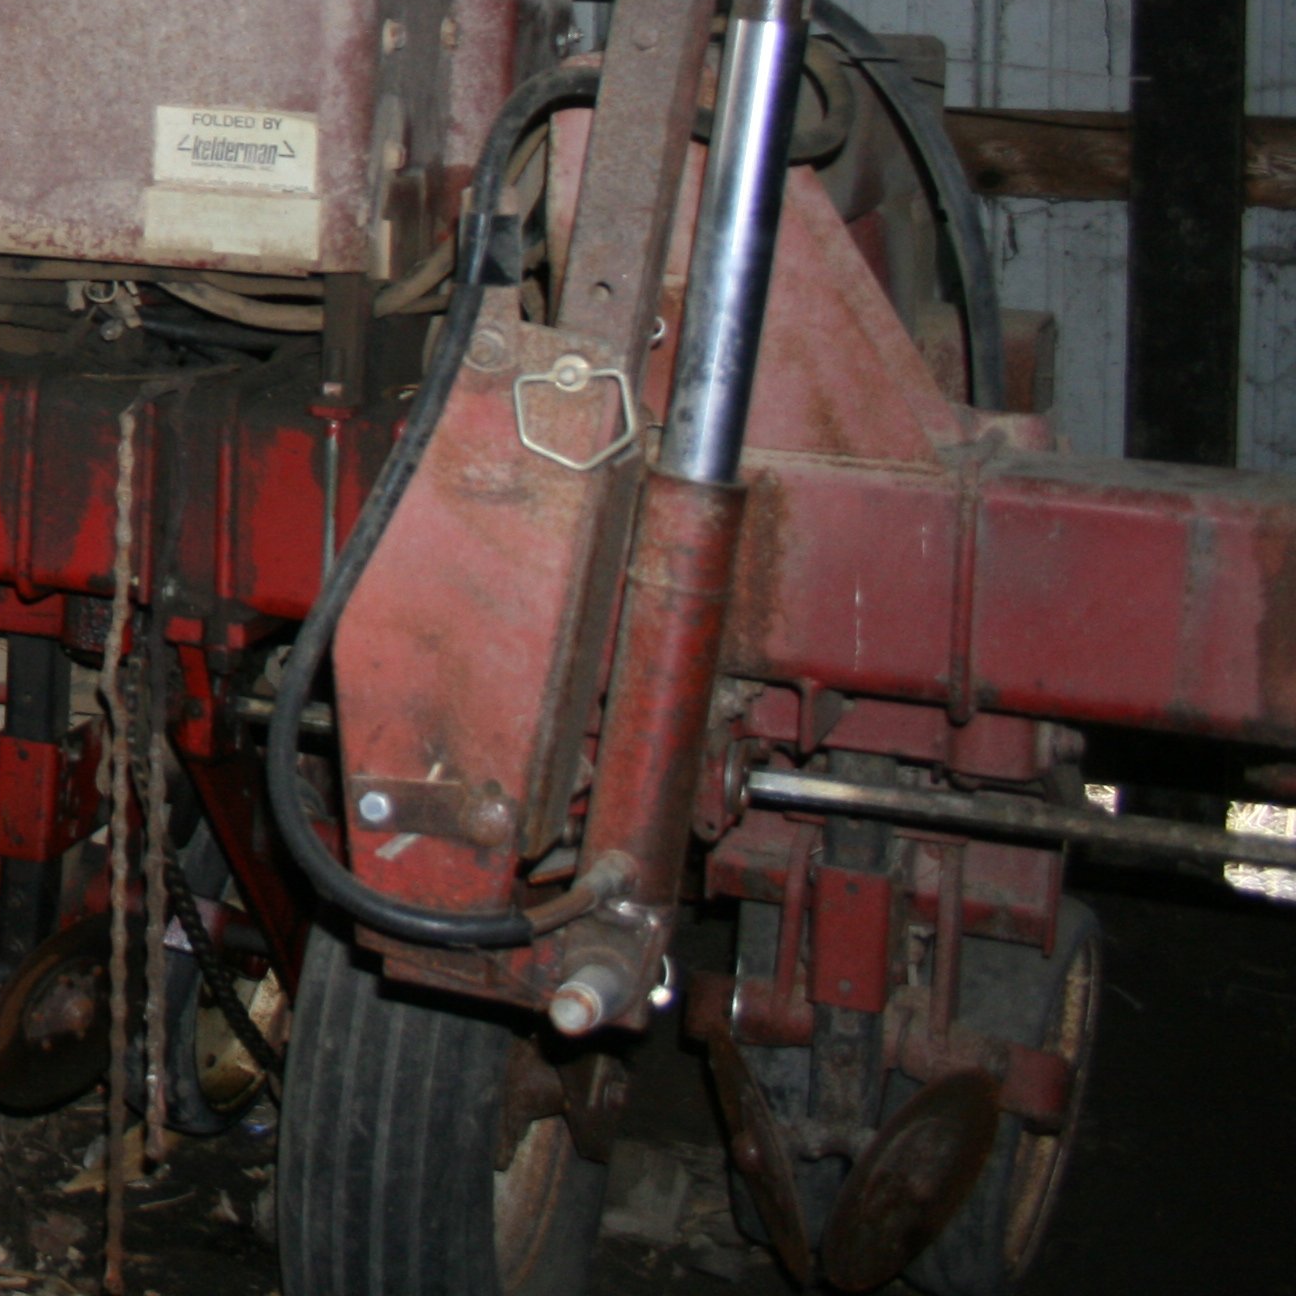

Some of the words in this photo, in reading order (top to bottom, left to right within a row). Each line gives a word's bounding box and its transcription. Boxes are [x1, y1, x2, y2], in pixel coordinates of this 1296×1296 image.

[192, 112, 257, 129] FOLDED
[262, 116, 283, 131] BY
[191, 135, 279, 165] kelderman
